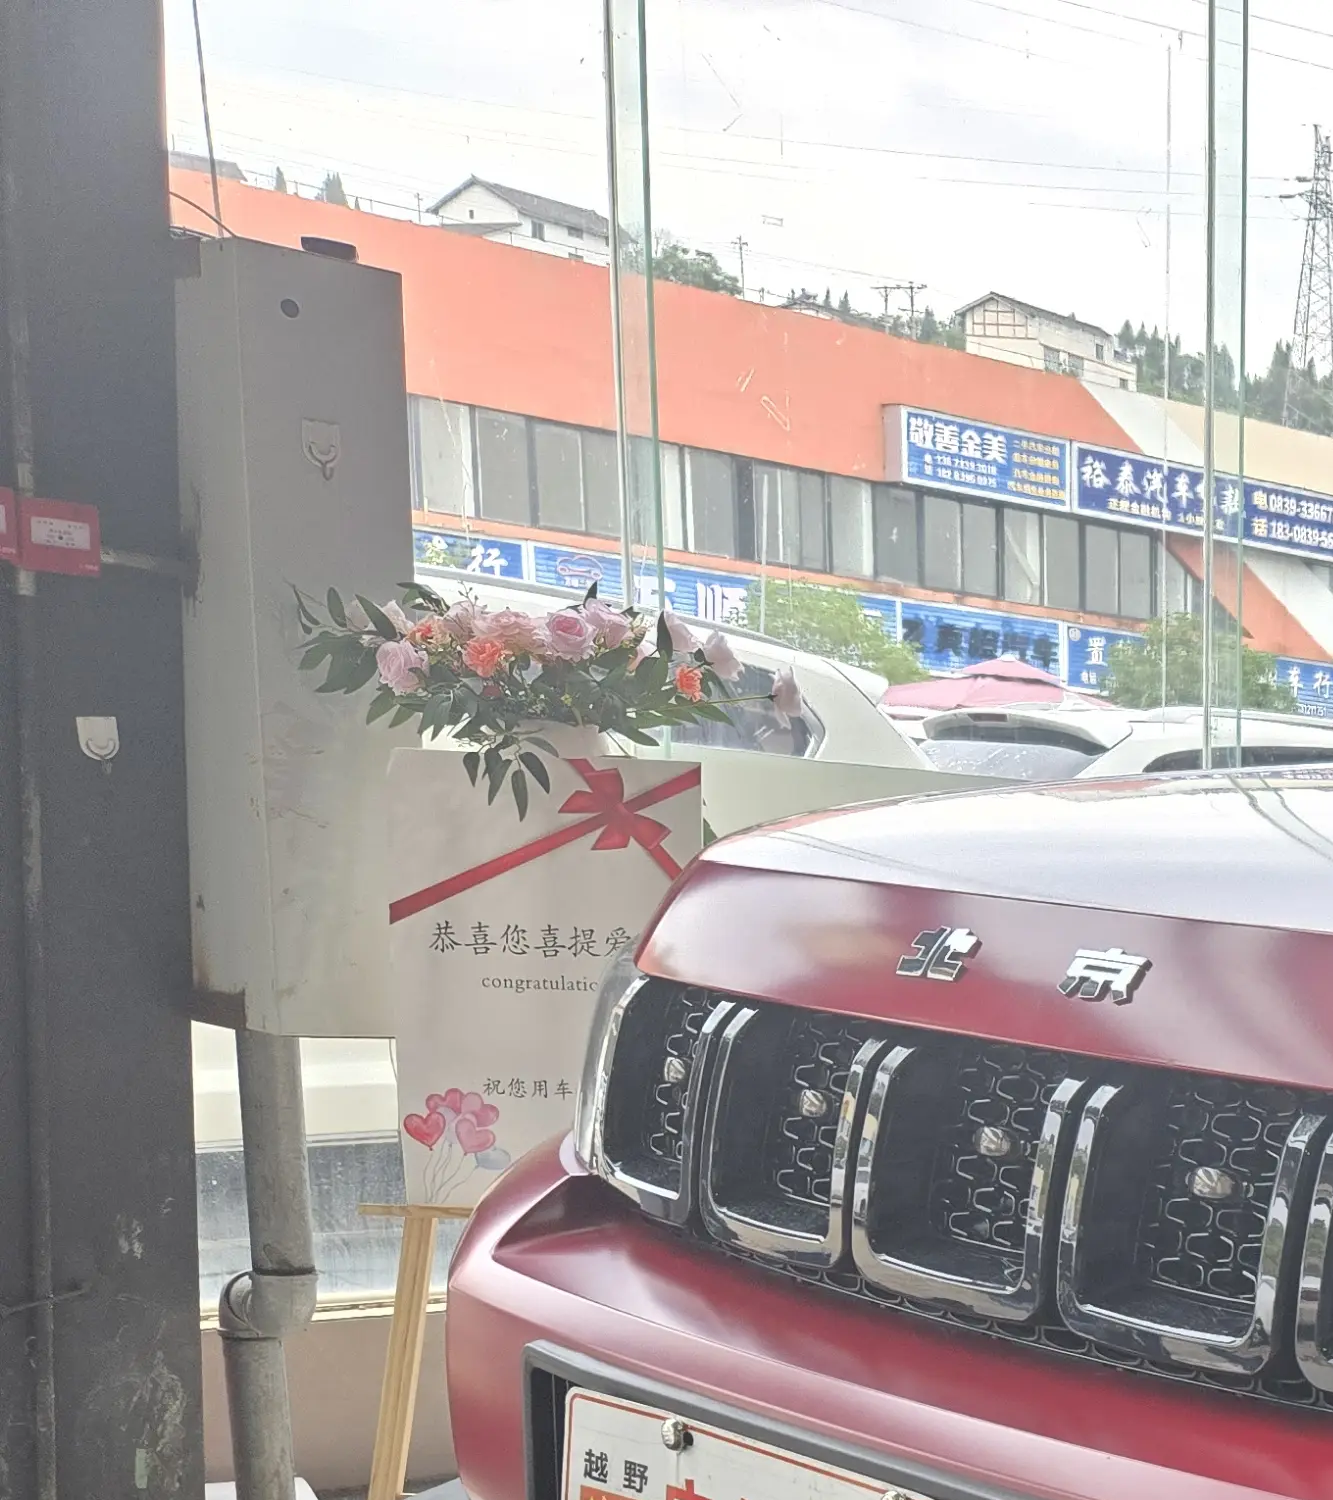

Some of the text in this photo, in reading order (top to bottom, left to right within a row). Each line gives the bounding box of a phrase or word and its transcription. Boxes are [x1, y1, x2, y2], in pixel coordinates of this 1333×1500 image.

[908, 416, 1007, 464] 敬善金美
[482, 1077, 573, 1100] 祝您用车
[583, 1449, 649, 1494] 越野
